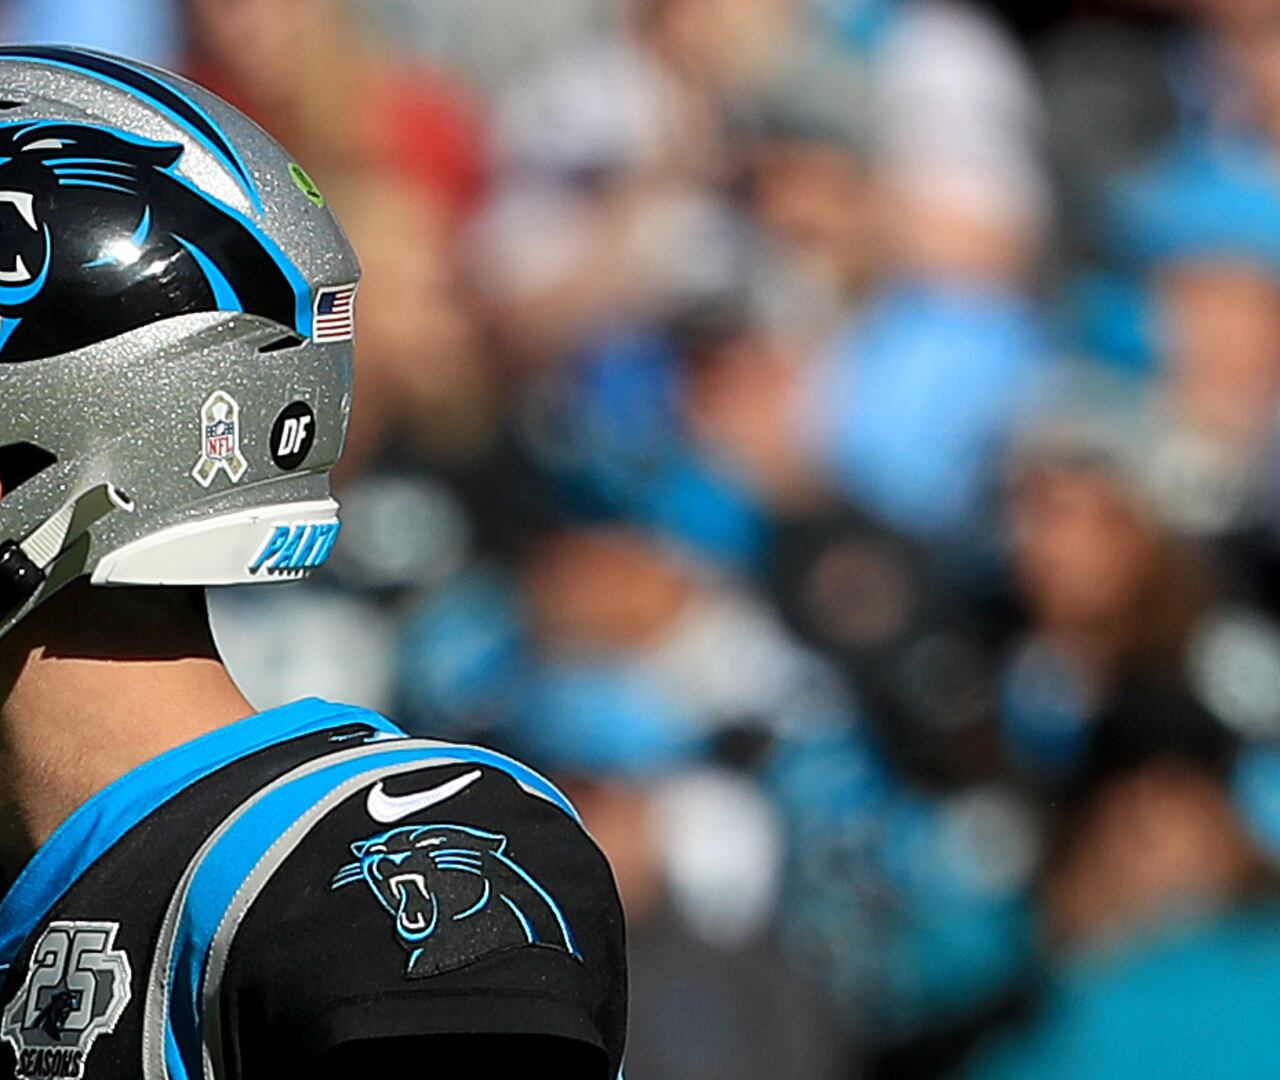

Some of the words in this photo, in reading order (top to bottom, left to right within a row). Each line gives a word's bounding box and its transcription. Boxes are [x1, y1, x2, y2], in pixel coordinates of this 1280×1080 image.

[208, 436, 234, 459] NFL
[277, 415, 312, 456] DF
[24, 929, 110, 1031] 25
[19, 1048, 83, 1078] SEASONS
